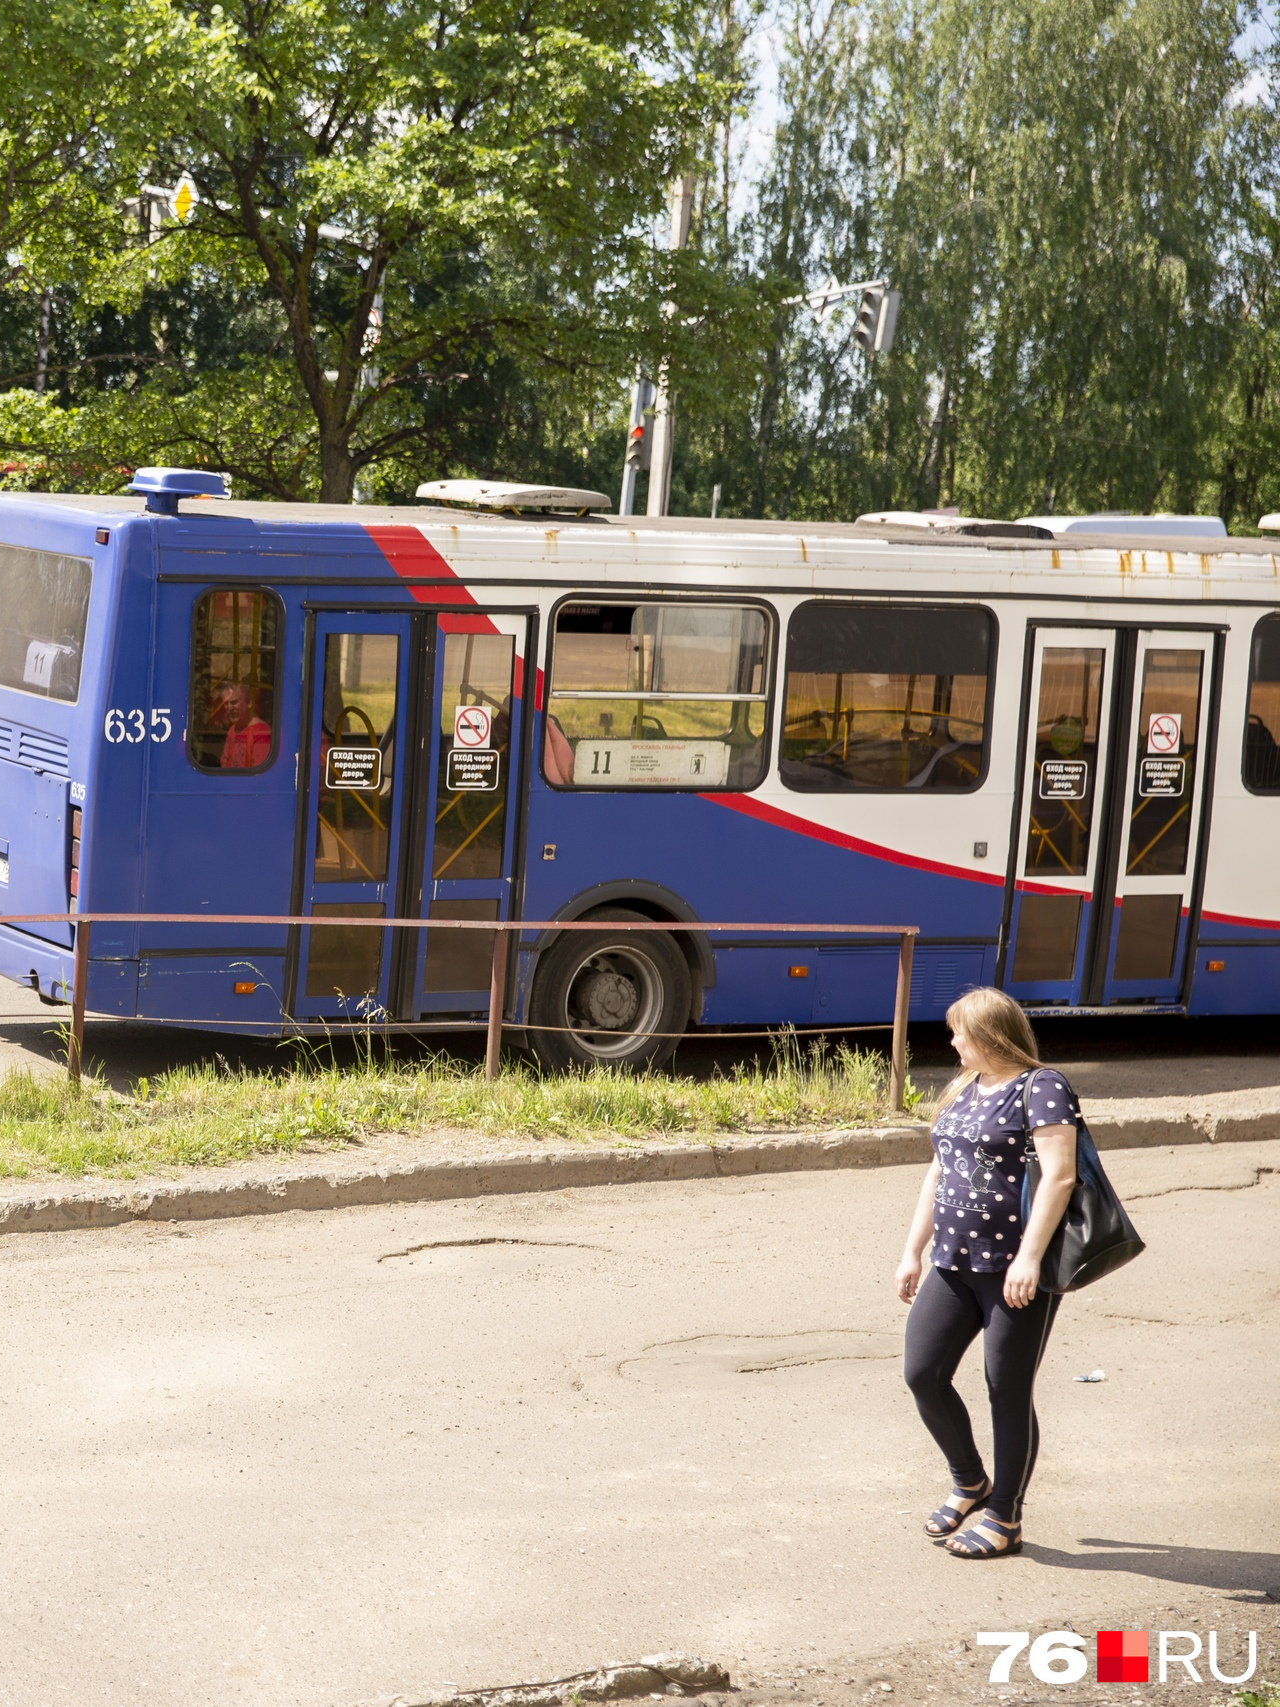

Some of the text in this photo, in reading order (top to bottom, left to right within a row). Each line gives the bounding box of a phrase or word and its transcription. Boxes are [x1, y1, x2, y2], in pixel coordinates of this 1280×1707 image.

[34, 652, 46, 674] 11
[105, 709, 171, 743] 635
[333, 752, 376, 762] ВХОД через
[453, 754, 494, 764] ВХОД через
[334, 762, 373, 770] переднюю
[591, 751, 611, 774] 11
[1145, 762, 1181, 772] ВХОД через
[454, 763, 492, 772] переднюю
[1046, 764, 1082, 774] ВХОД через
[342, 770, 364, 779] дверь
[462, 772, 483, 781] дверь
[1047, 773, 1080, 781] переднюю
[1146, 771, 1179, 779] переднюю
[1053, 781, 1072, 790] дверь
[1152, 779, 1171, 787] дверь
[71, 781, 86, 800] 635
